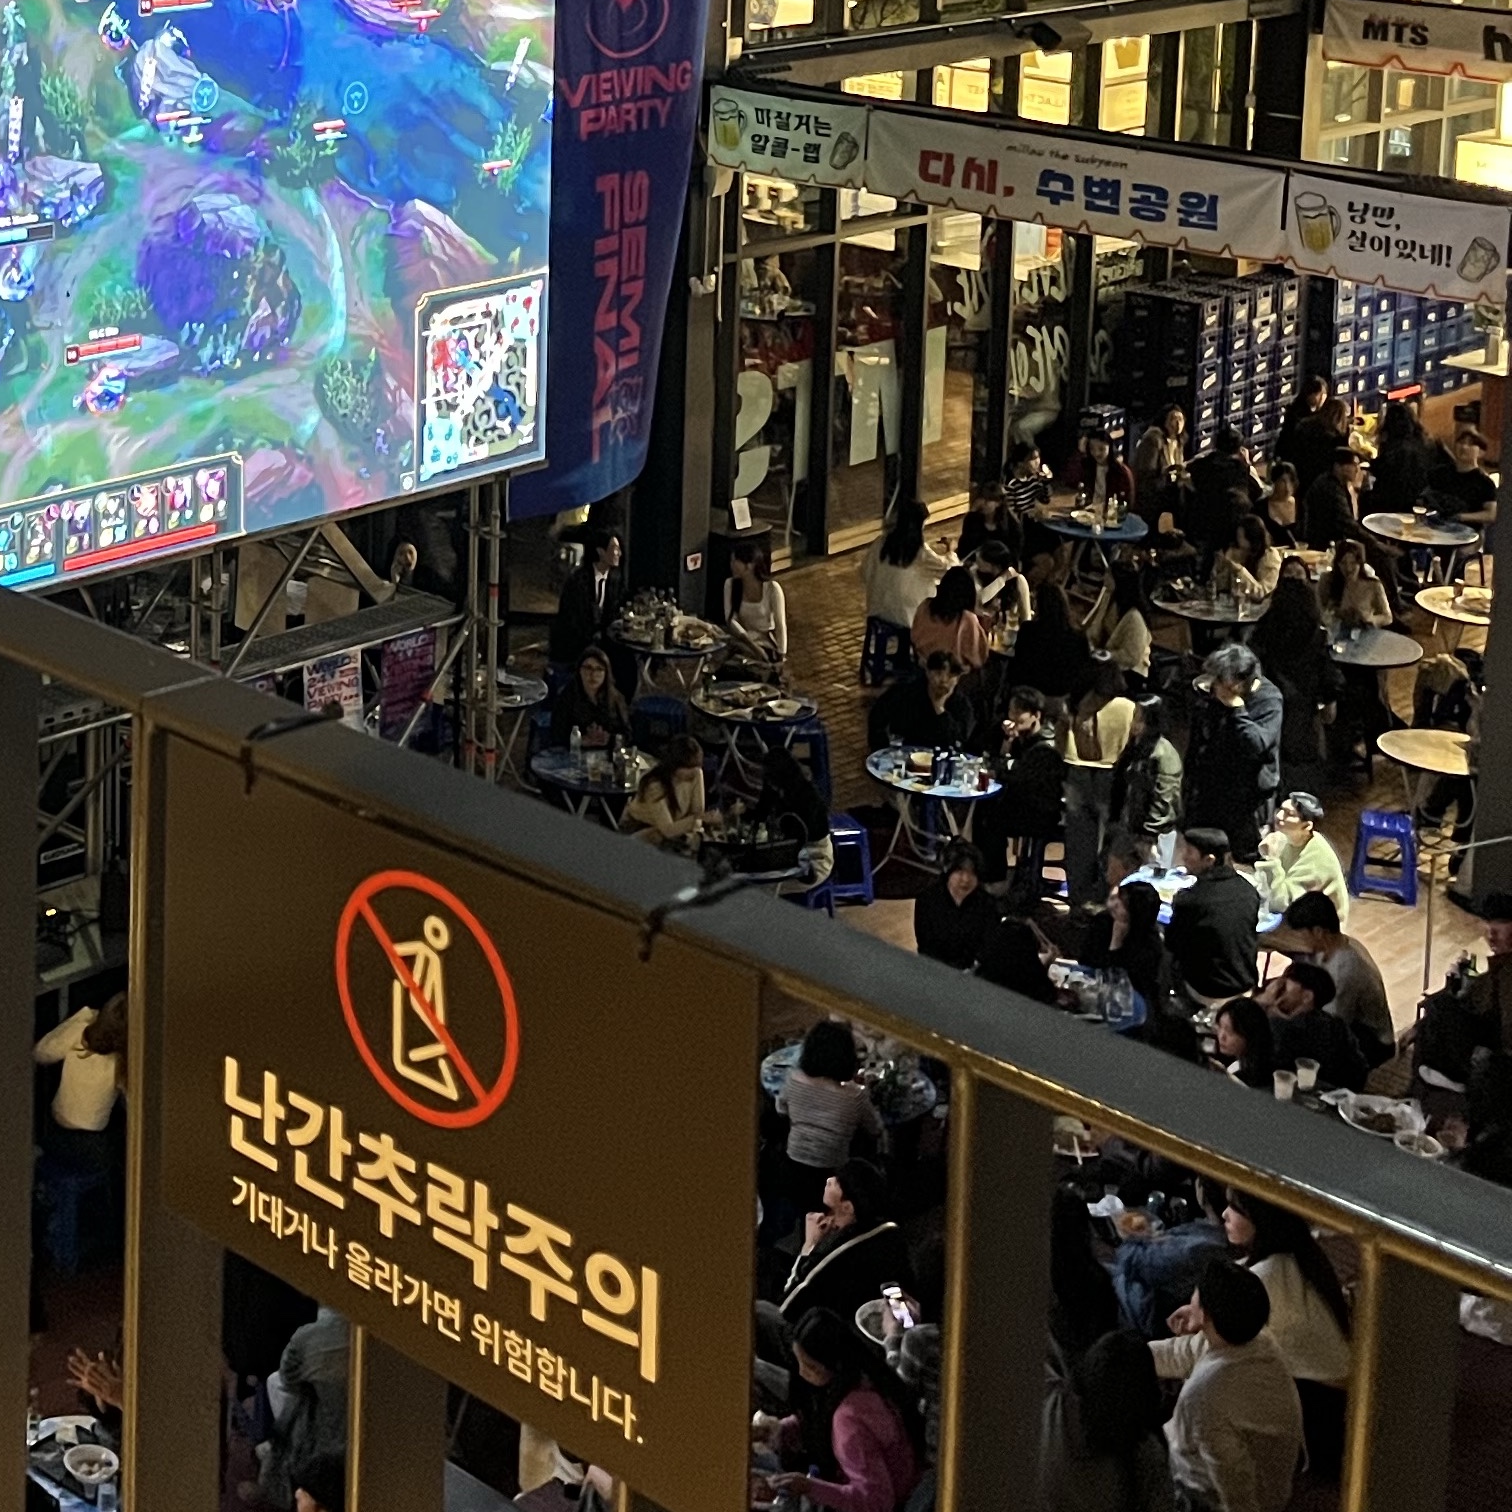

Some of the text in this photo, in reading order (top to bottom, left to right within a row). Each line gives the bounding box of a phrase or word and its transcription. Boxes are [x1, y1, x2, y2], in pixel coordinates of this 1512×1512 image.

[1362, 19, 1429, 46] MTS
[558, 60, 692, 108] VIEWING
[579, 97, 672, 141] PARTY
[755, 107, 832, 137] 마실거는
[919, 149, 1219, 231] 다시, 수변공원
[617, 172, 650, 370] SEMI
[1347, 229, 1453, 268] 살아있네!
[591, 174, 622, 464] FINAL
[307, 676, 360, 699] VIEWING
[223, 1055, 661, 1384] 난간추락주의
[231, 1174, 645, 1446] 기대거나 올라가면 위험합니다.
